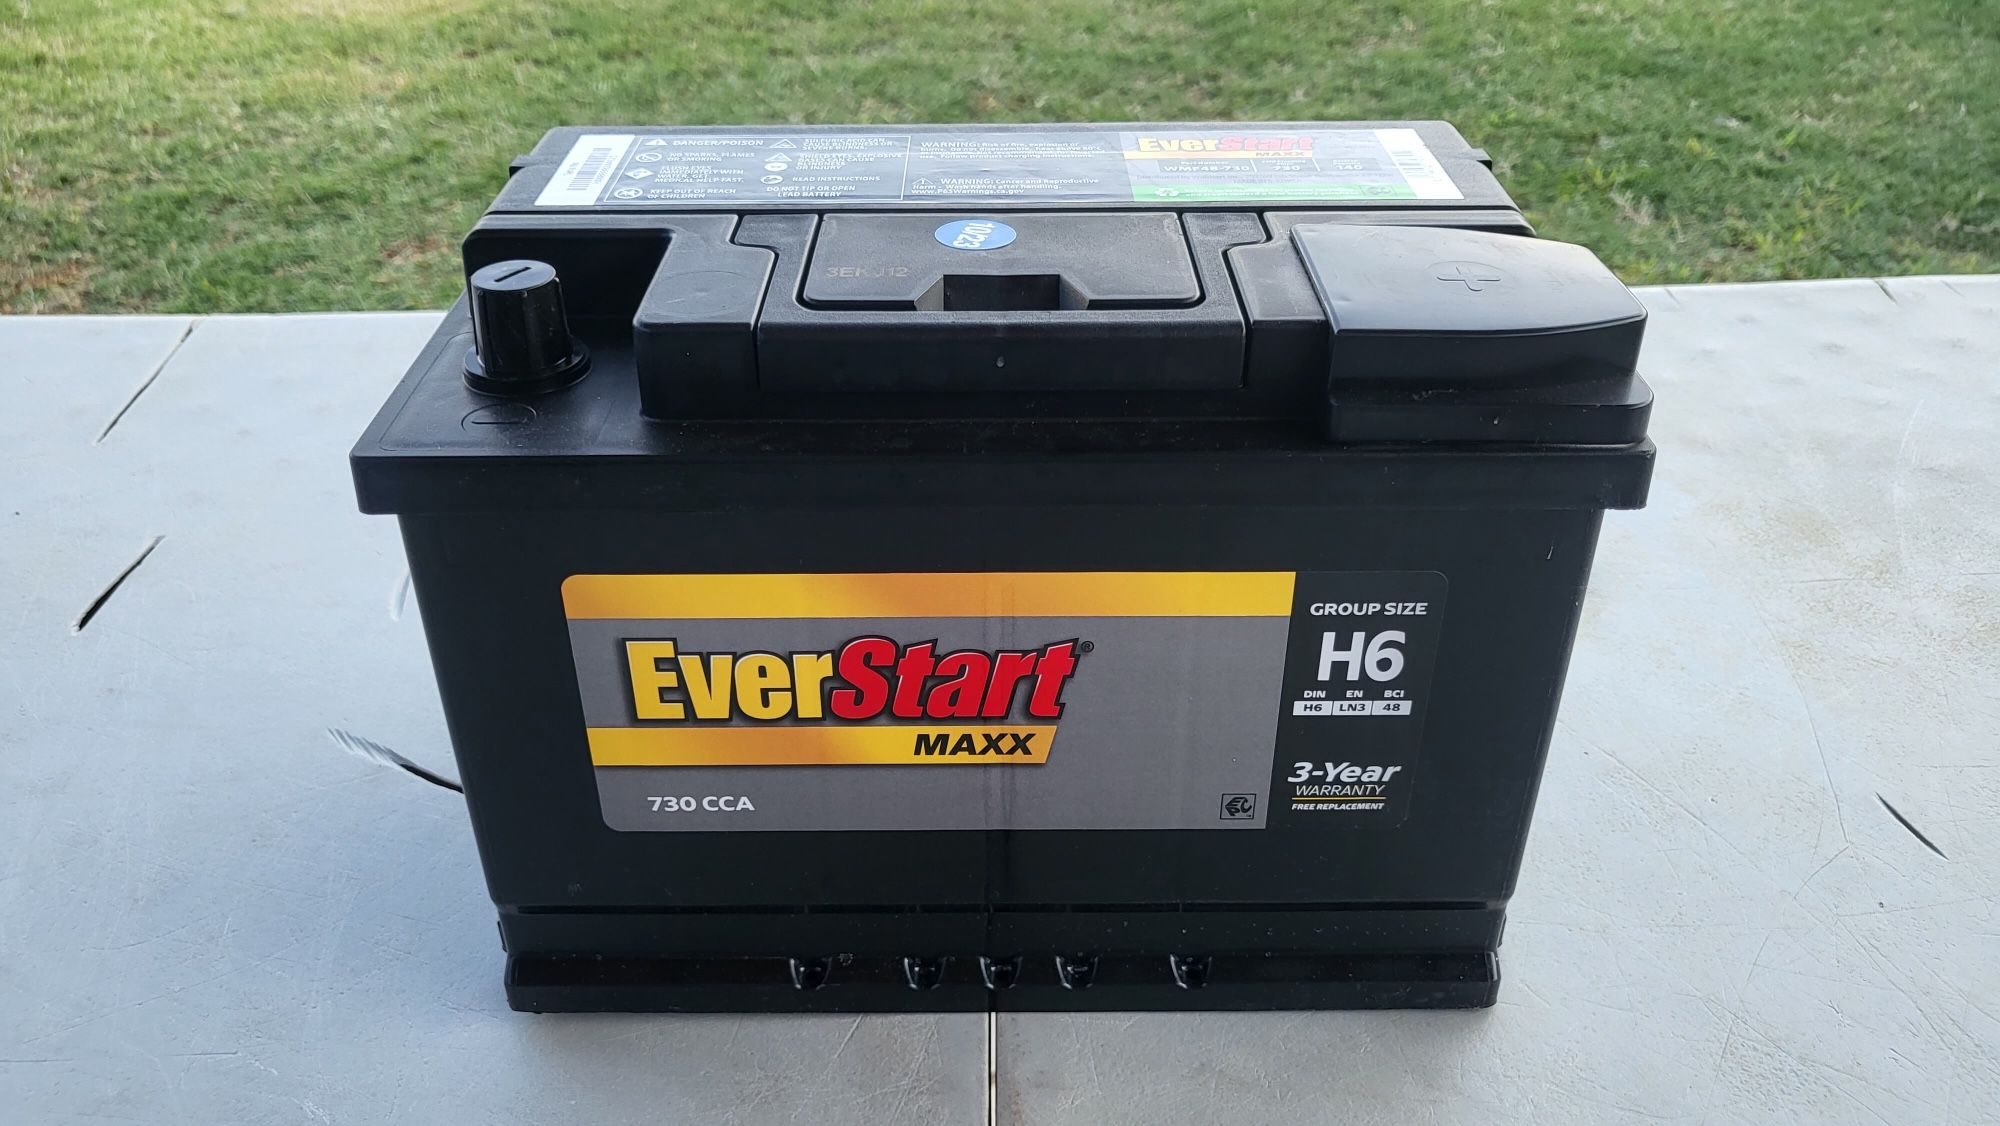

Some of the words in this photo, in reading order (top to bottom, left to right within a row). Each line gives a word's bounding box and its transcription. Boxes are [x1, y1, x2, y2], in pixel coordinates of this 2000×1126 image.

[1137, 136, 1314, 151] EverStart
[953, 223, 995, 248] 10/23
[1309, 602, 1382, 616] GROUP
[1383, 602, 1429, 616] SIZE
[1317, 629, 1406, 682] H6
[622, 635, 1078, 721] EverStart
[1303, 690, 1326, 699] DIN
[1345, 690, 1365, 698] EN
[1383, 690, 1405, 698] BCI
[1303, 704, 1323, 712] H6
[1338, 703, 1366, 712] LN3
[1382, 703, 1401, 711] 48
[914, 733, 1037, 756] MAXX
[1287, 761, 1402, 783] 3-Year
[1295, 784, 1386, 796] WARRANTY
[647, 796, 697, 811] 730
[701, 796, 756, 811] CCA
[1291, 803, 1315, 811] FREE
[1316, 803, 1385, 811] REPLACEMENT
